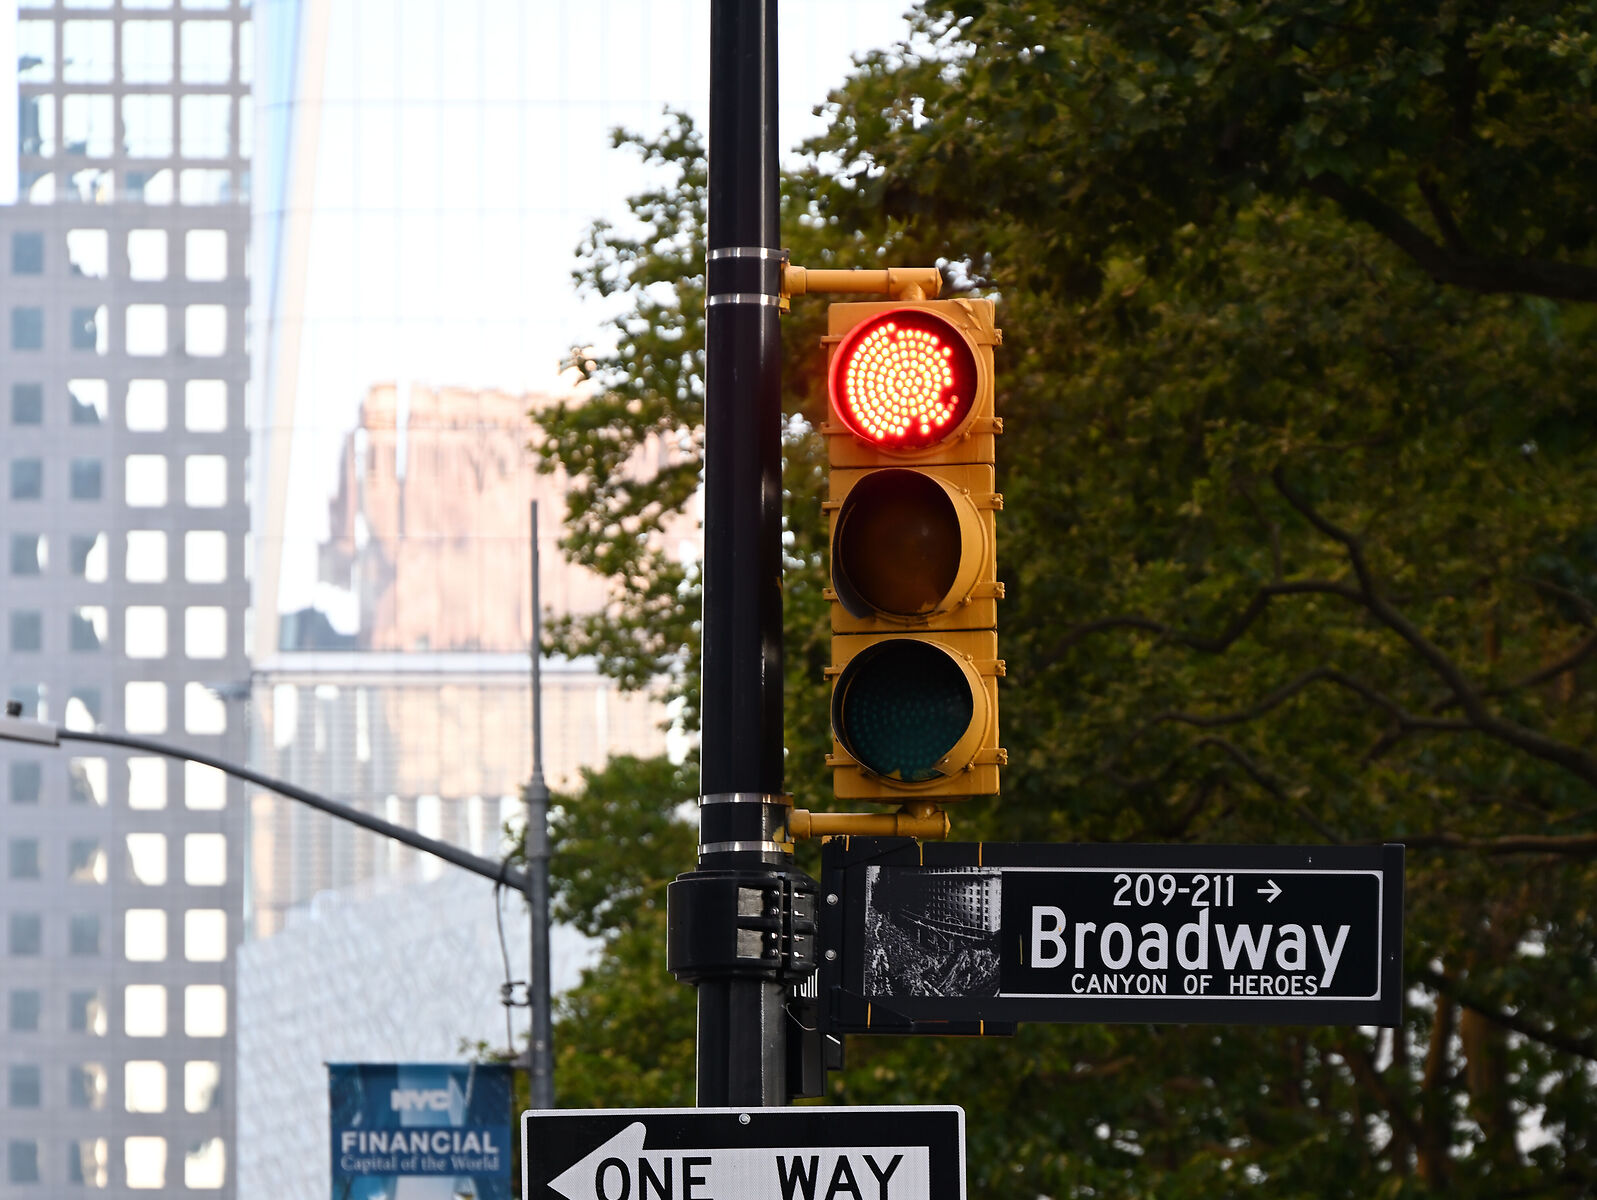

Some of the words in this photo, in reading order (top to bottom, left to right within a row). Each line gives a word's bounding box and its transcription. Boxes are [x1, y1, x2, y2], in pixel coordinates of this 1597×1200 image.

[1113, 873, 1234, 907] 209-211
[1031, 906, 1350, 988] Broadway
[1071, 973, 1167, 994] CANYON
[1184, 974, 1213, 994] OF
[1230, 975, 1318, 996] HEROES
[390, 1089, 450, 1111] NYC
[341, 1131, 499, 1153] FINANCIAL
[341, 1155, 397, 1174] Capital
[401, 1155, 419, 1170] of
[421, 1155, 446, 1170] the
[450, 1155, 499, 1170] World
